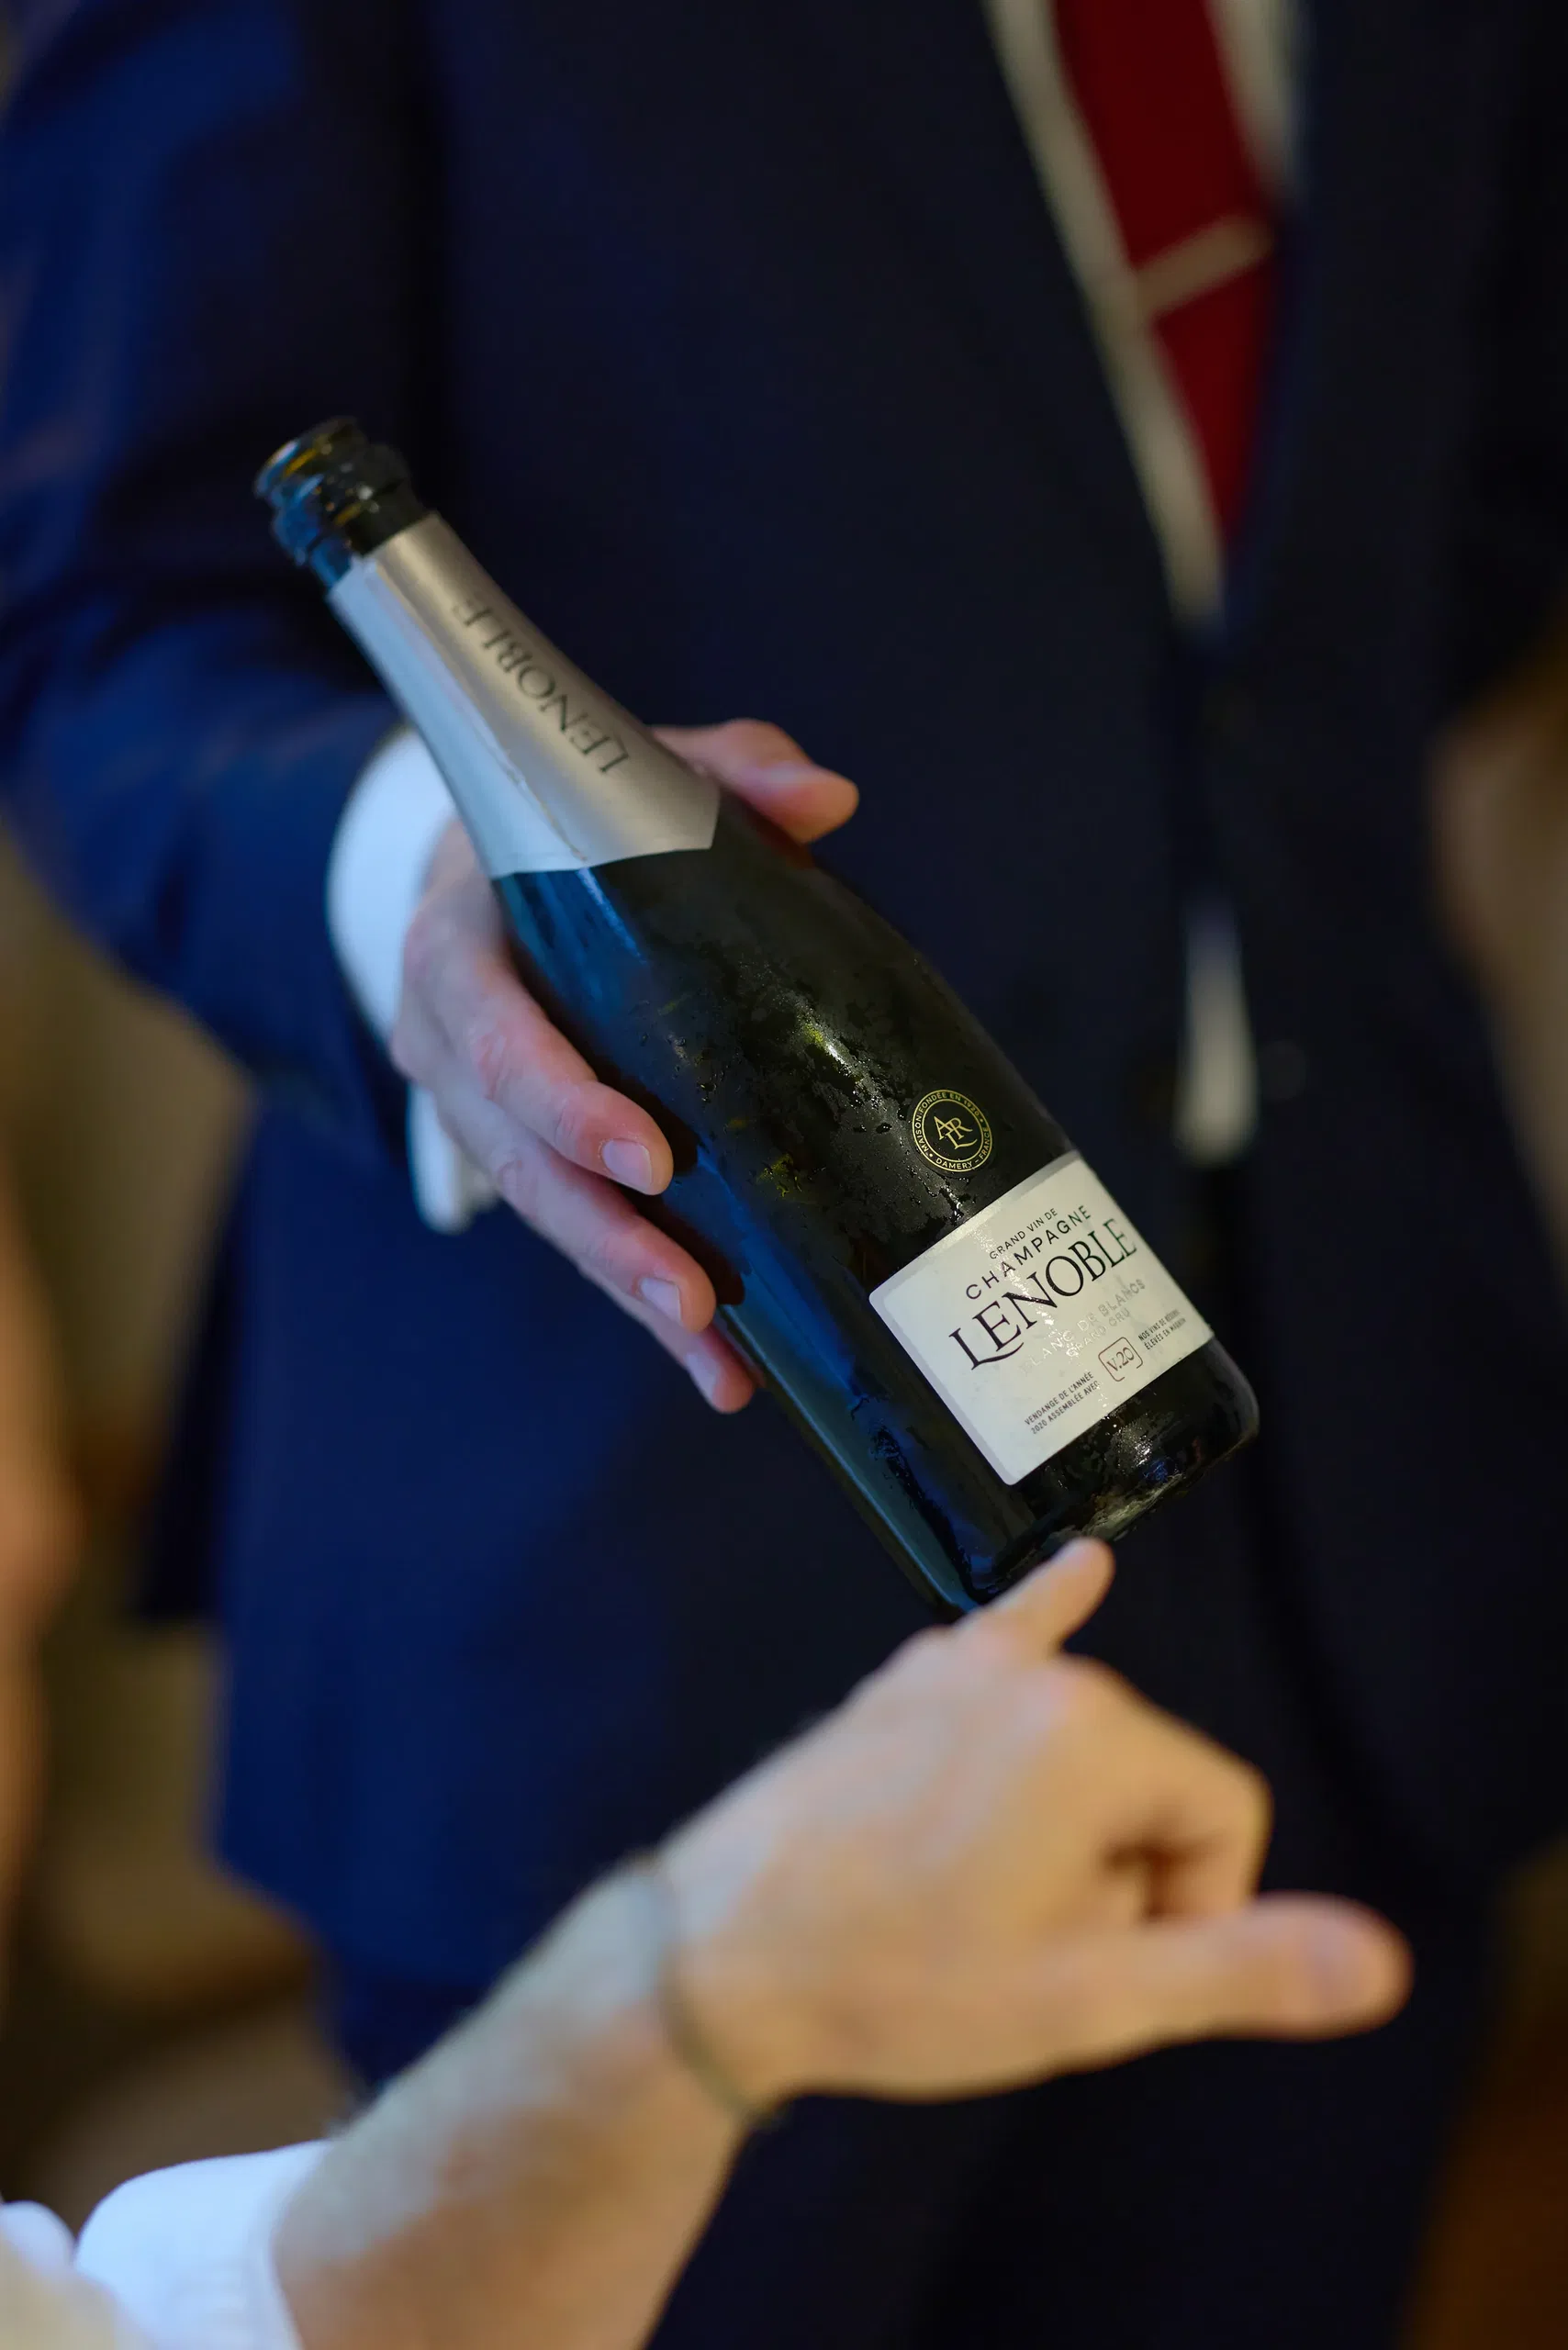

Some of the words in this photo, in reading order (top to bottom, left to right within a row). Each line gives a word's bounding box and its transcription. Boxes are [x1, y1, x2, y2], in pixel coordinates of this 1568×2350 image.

[452, 599, 629, 772] LENOBLE
[914, 1114, 930, 1153] MAISON
[949, 1092, 962, 1102] EN
[935, 1158, 973, 1169] DAMERY
[978, 1126, 991, 1160] FRANCE
[966, 1205, 1092, 1300] CHAMPAGNE
[989, 1230, 1026, 1259] GRAND
[1026, 1217, 1045, 1232] VIN
[1045, 1208, 1058, 1221] DE
[948, 1218, 1137, 1371] LENOBLE
[1106, 1347, 1135, 1371] V.20
[1138, 1329, 1150, 1341] NOS
[1025, 1397, 1059, 1426] VENDANGE
[1058, 1390, 1069, 1401] DE
[1031, 1419, 1047, 1435] 2020
[1047, 1393, 1084, 1422] ASSEMBLÉE
[1083, 1380, 1100, 1395] AVEC
